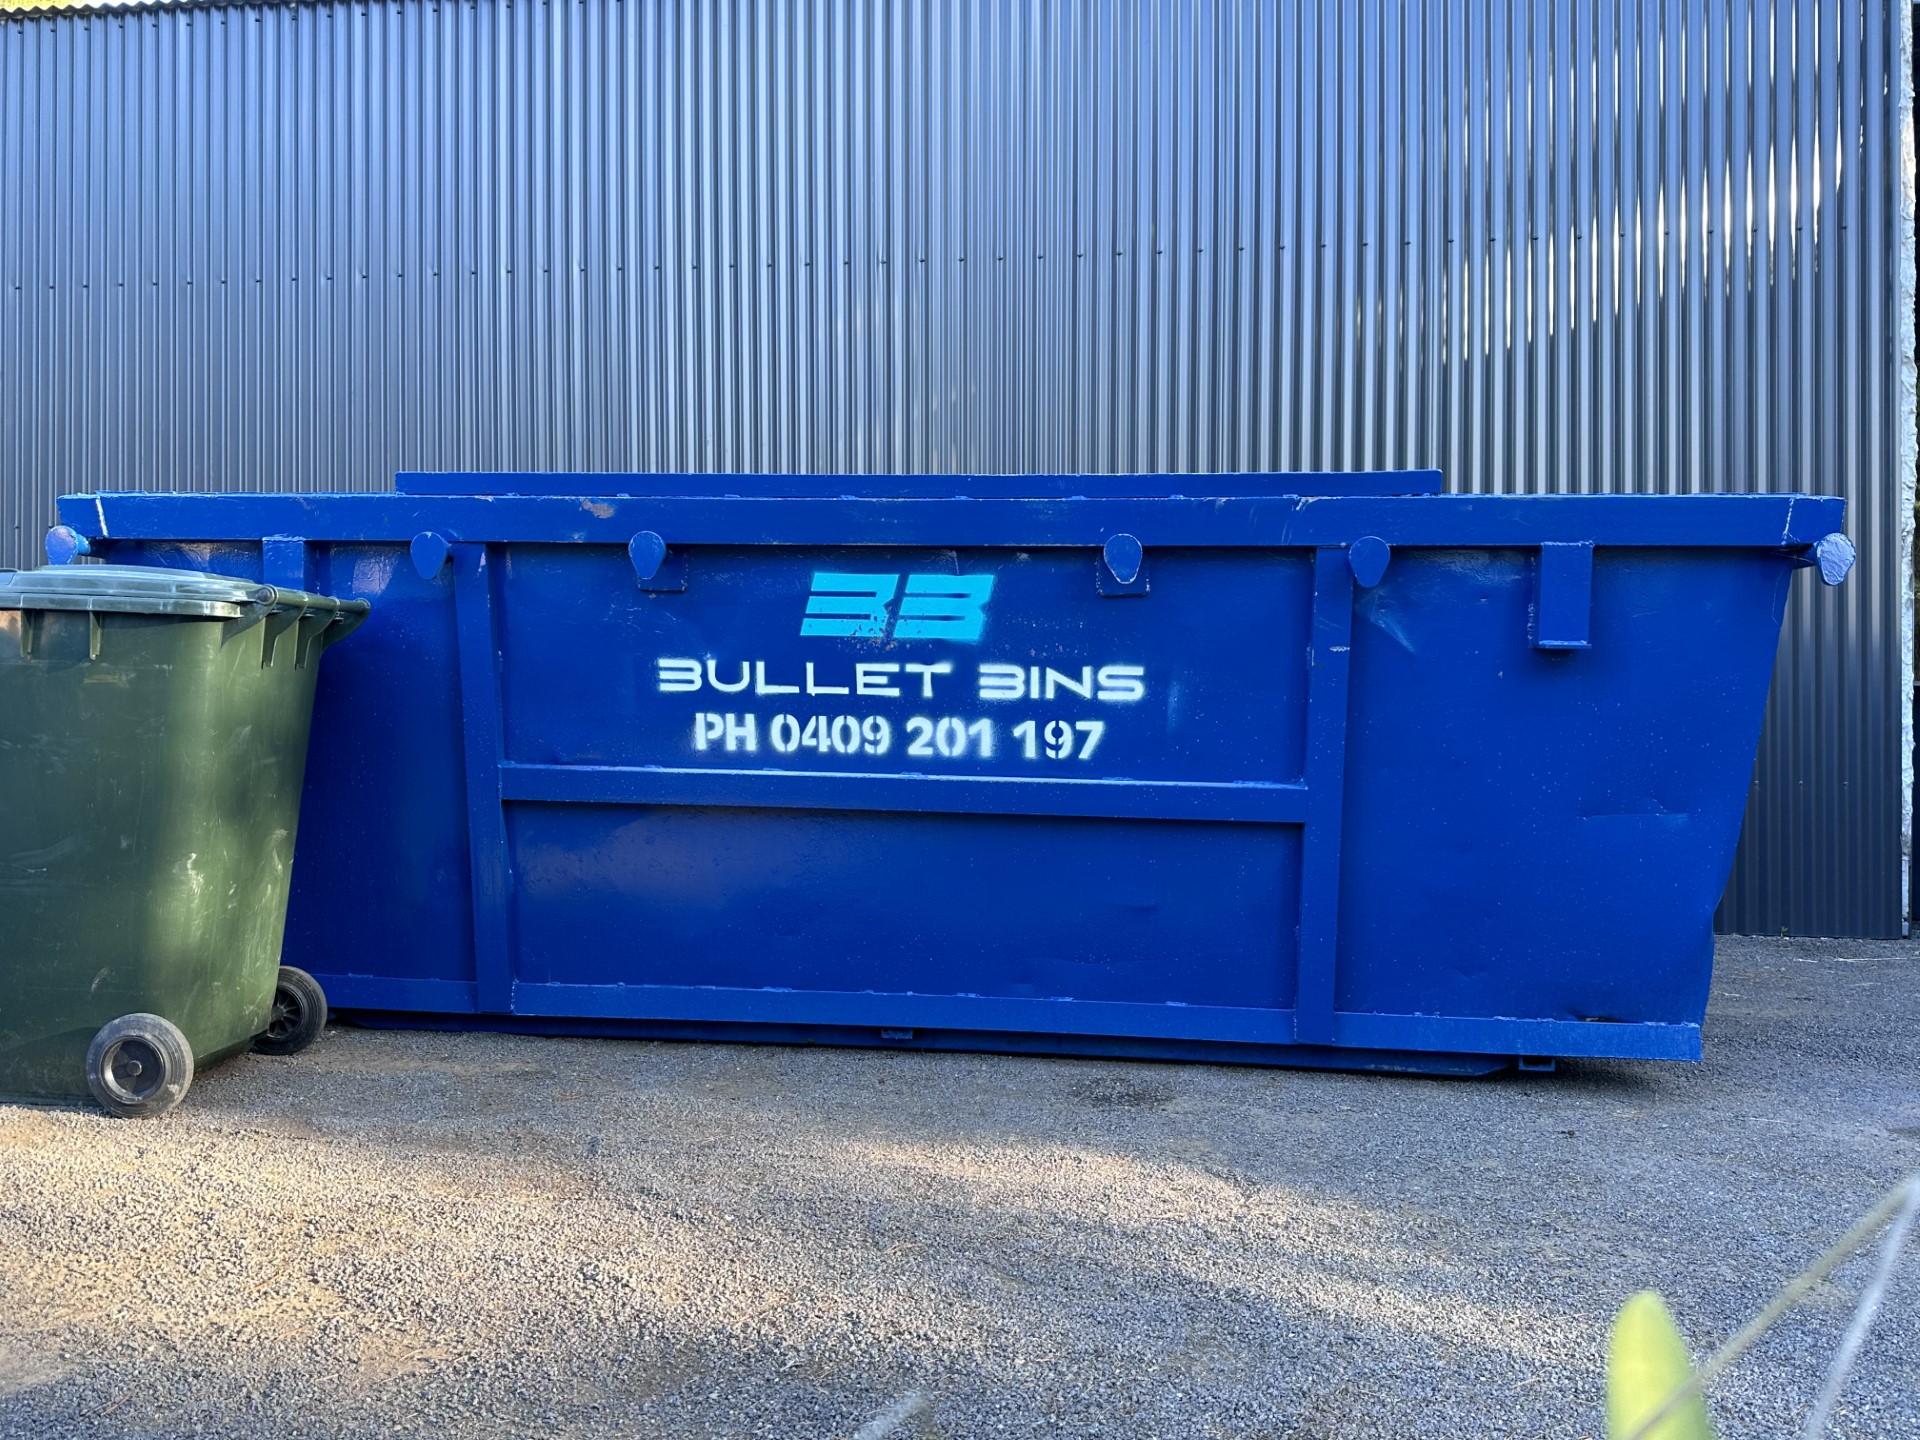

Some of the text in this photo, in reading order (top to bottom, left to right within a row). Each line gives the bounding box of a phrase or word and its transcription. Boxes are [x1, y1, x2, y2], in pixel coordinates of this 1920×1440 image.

[657, 658, 1145, 702] BULLET BINS
[693, 712, 1105, 760] PH 0409 201 197
